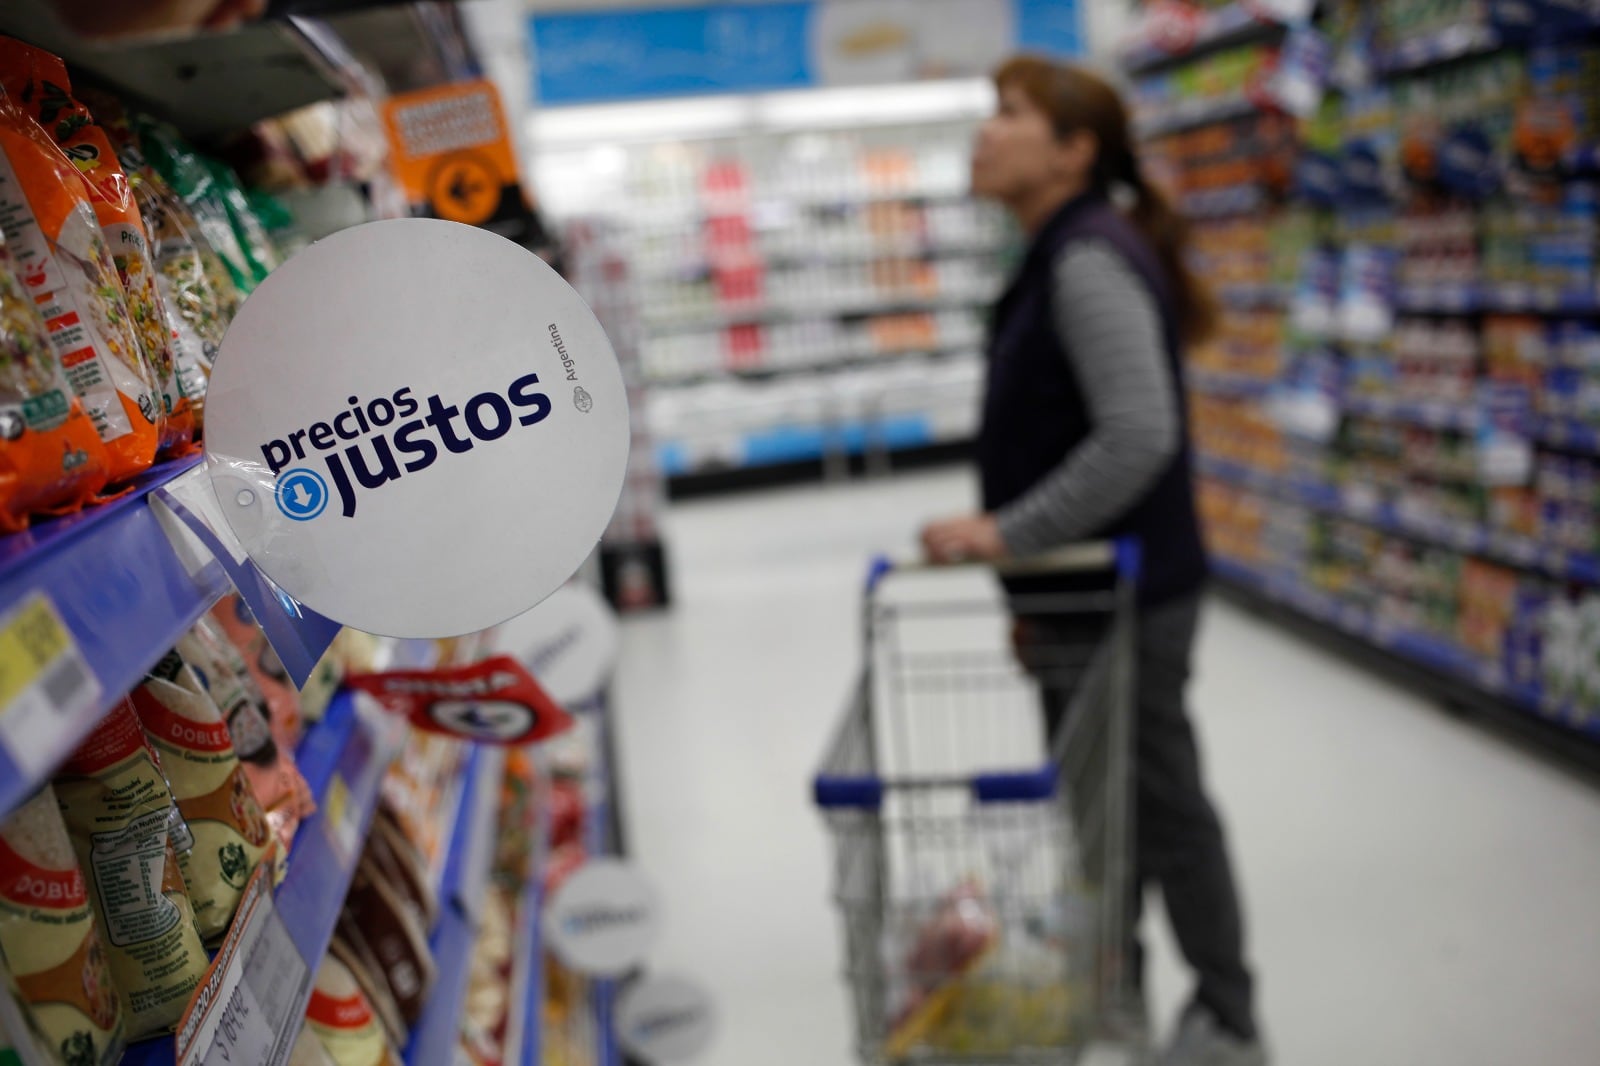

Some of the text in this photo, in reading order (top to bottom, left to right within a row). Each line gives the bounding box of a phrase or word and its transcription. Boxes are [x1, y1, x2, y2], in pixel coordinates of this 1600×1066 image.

[548, 323, 578, 381] Argentina
[260, 386, 419, 478] precios
[324, 373, 552, 518] justos
[171, 723, 222, 746] DOBLE
[15, 873, 86, 900] DOBLE
